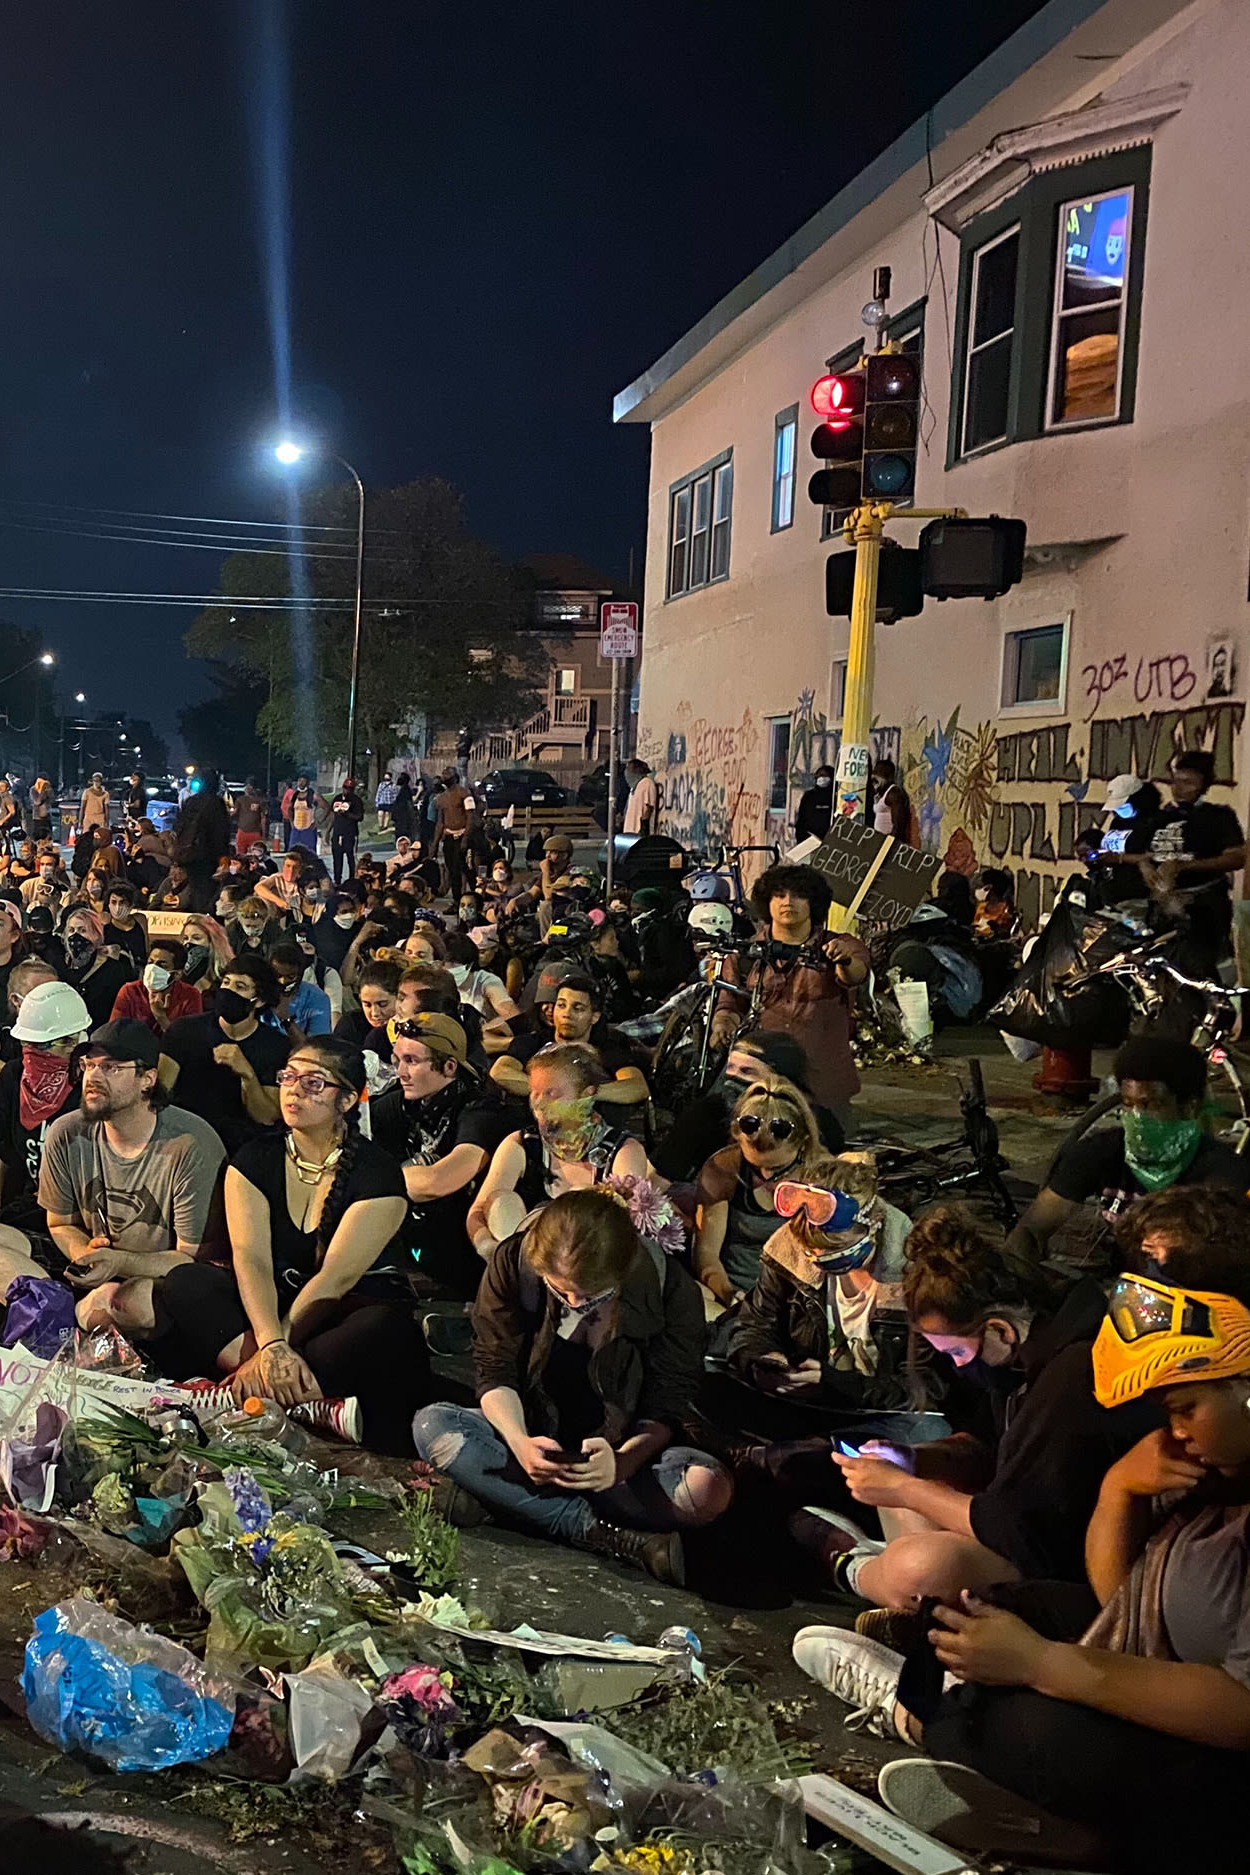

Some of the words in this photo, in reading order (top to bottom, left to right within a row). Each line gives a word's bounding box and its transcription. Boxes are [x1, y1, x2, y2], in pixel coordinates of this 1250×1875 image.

[603, 634, 635, 642] EMERGENCY
[1134, 654, 1197, 702] UTB
[655, 769, 696, 814] BLACK
[830, 816, 875, 846] RIP
[892, 843, 935, 873] RIP
[113, 1385, 137, 1393] REST
